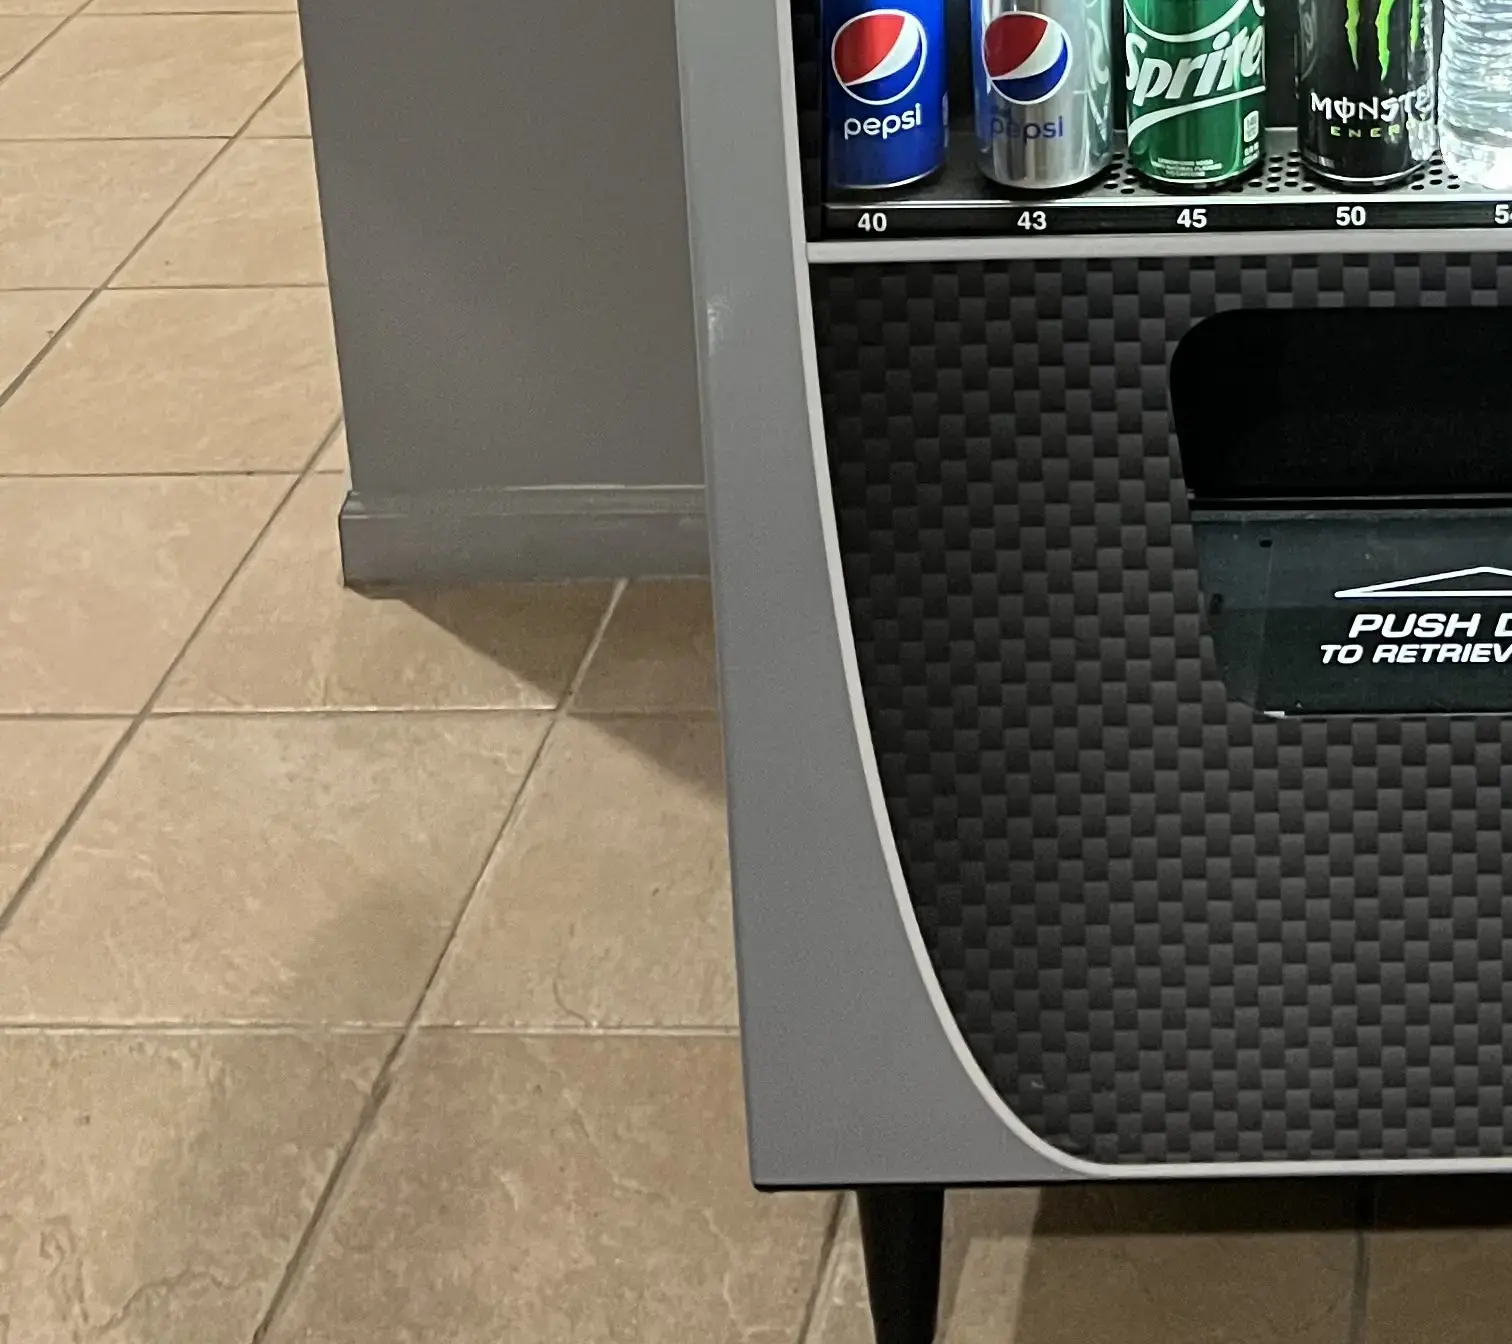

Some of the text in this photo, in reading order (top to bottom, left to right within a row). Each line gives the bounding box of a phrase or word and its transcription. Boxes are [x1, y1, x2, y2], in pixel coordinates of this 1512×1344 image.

[1126, 26, 1263, 107] Sprite
[844, 103, 921, 140] pepsi
[990, 116, 1063, 143] pepsi
[858, 212, 887, 231] 40
[1017, 211, 1047, 230] 43
[1177, 209, 1208, 227] 45
[1336, 206, 1366, 225] 50
[1348, 612, 1481, 638] PUSH
[1321, 645, 1363, 664] TO
